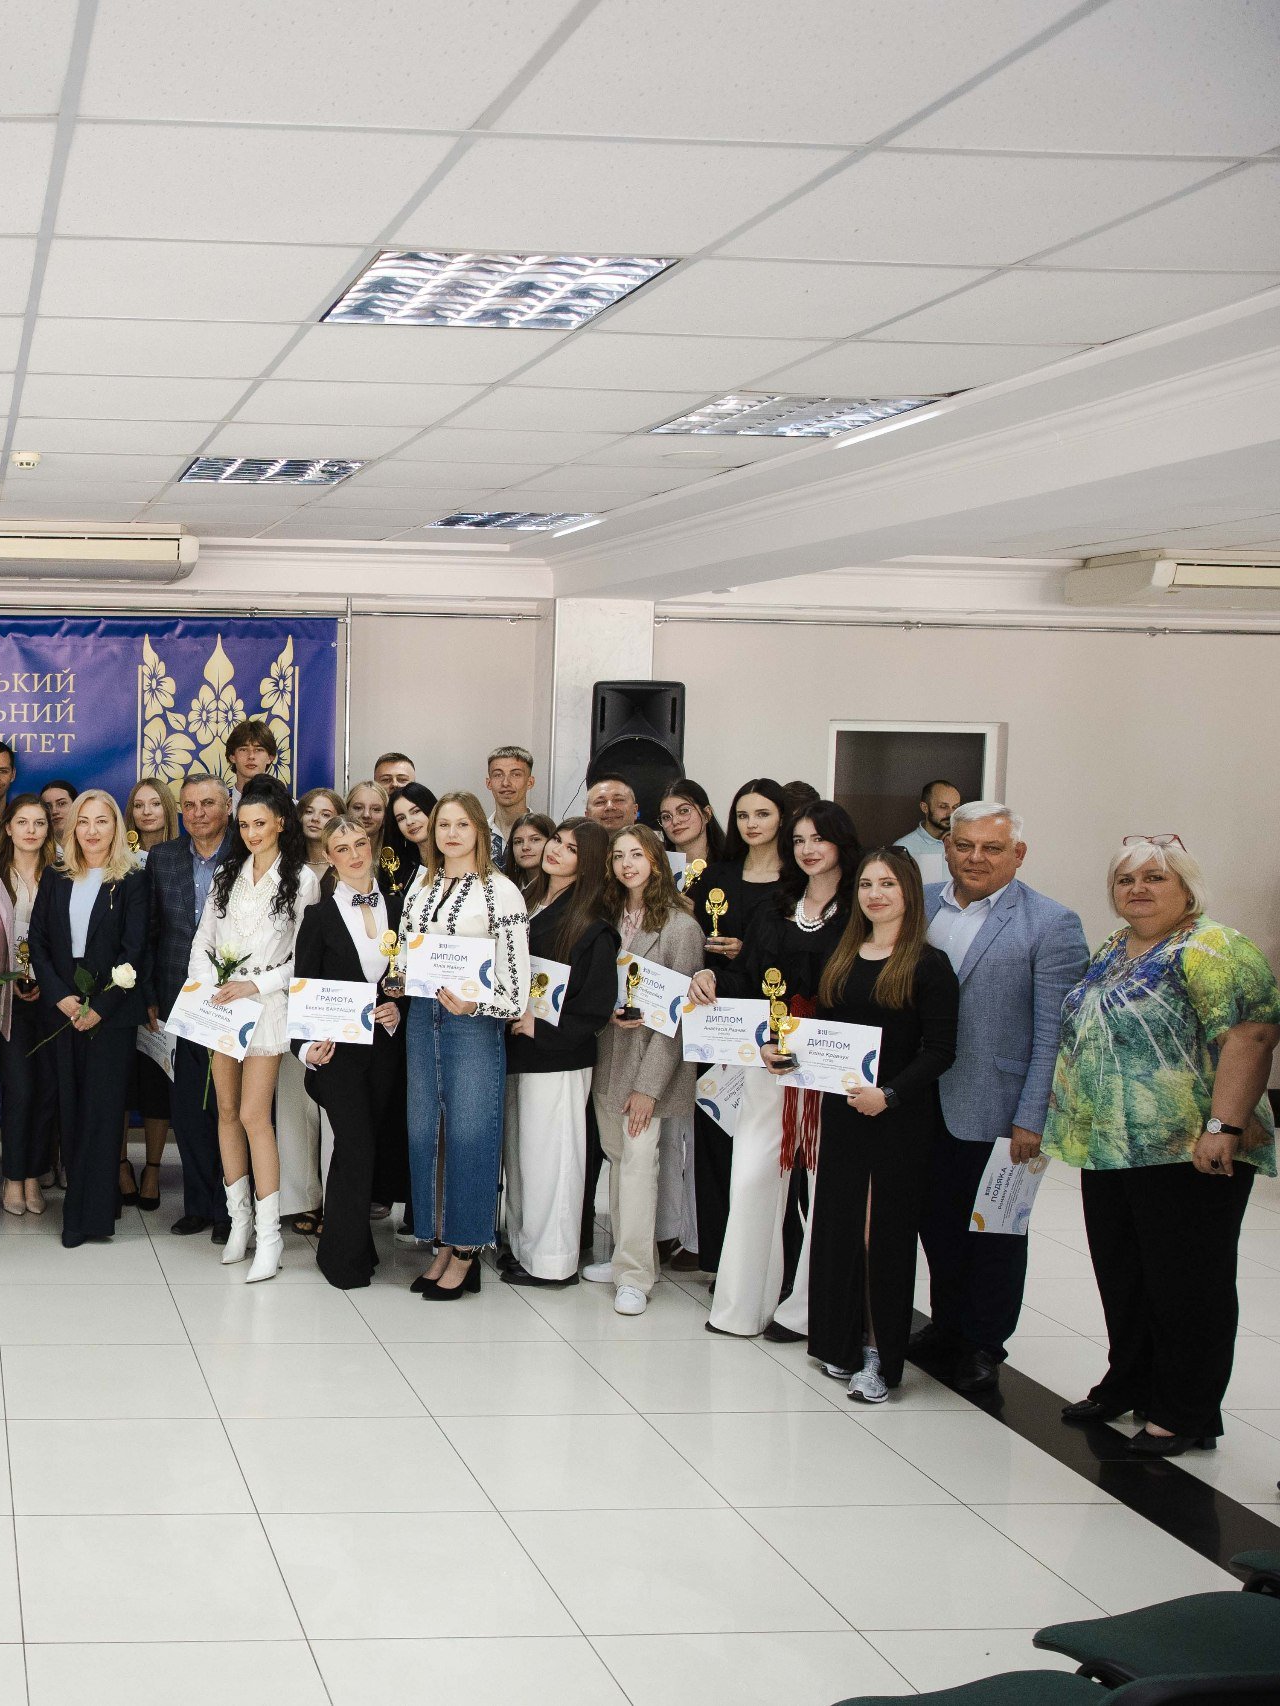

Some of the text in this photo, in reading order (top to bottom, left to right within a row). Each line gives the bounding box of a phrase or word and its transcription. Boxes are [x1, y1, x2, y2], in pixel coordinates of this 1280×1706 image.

[430, 952, 468, 962] ДИПЛОМ
[639, 974, 665, 991] ИПЛОМ
[315, 995, 354, 1004] ГРАМОТА
[705, 1015, 743, 1024] ДИПЛОМ
[807, 1038, 851, 1050] ДИПЛОМ
[991, 1166, 1008, 1203] ПОДЯКА
